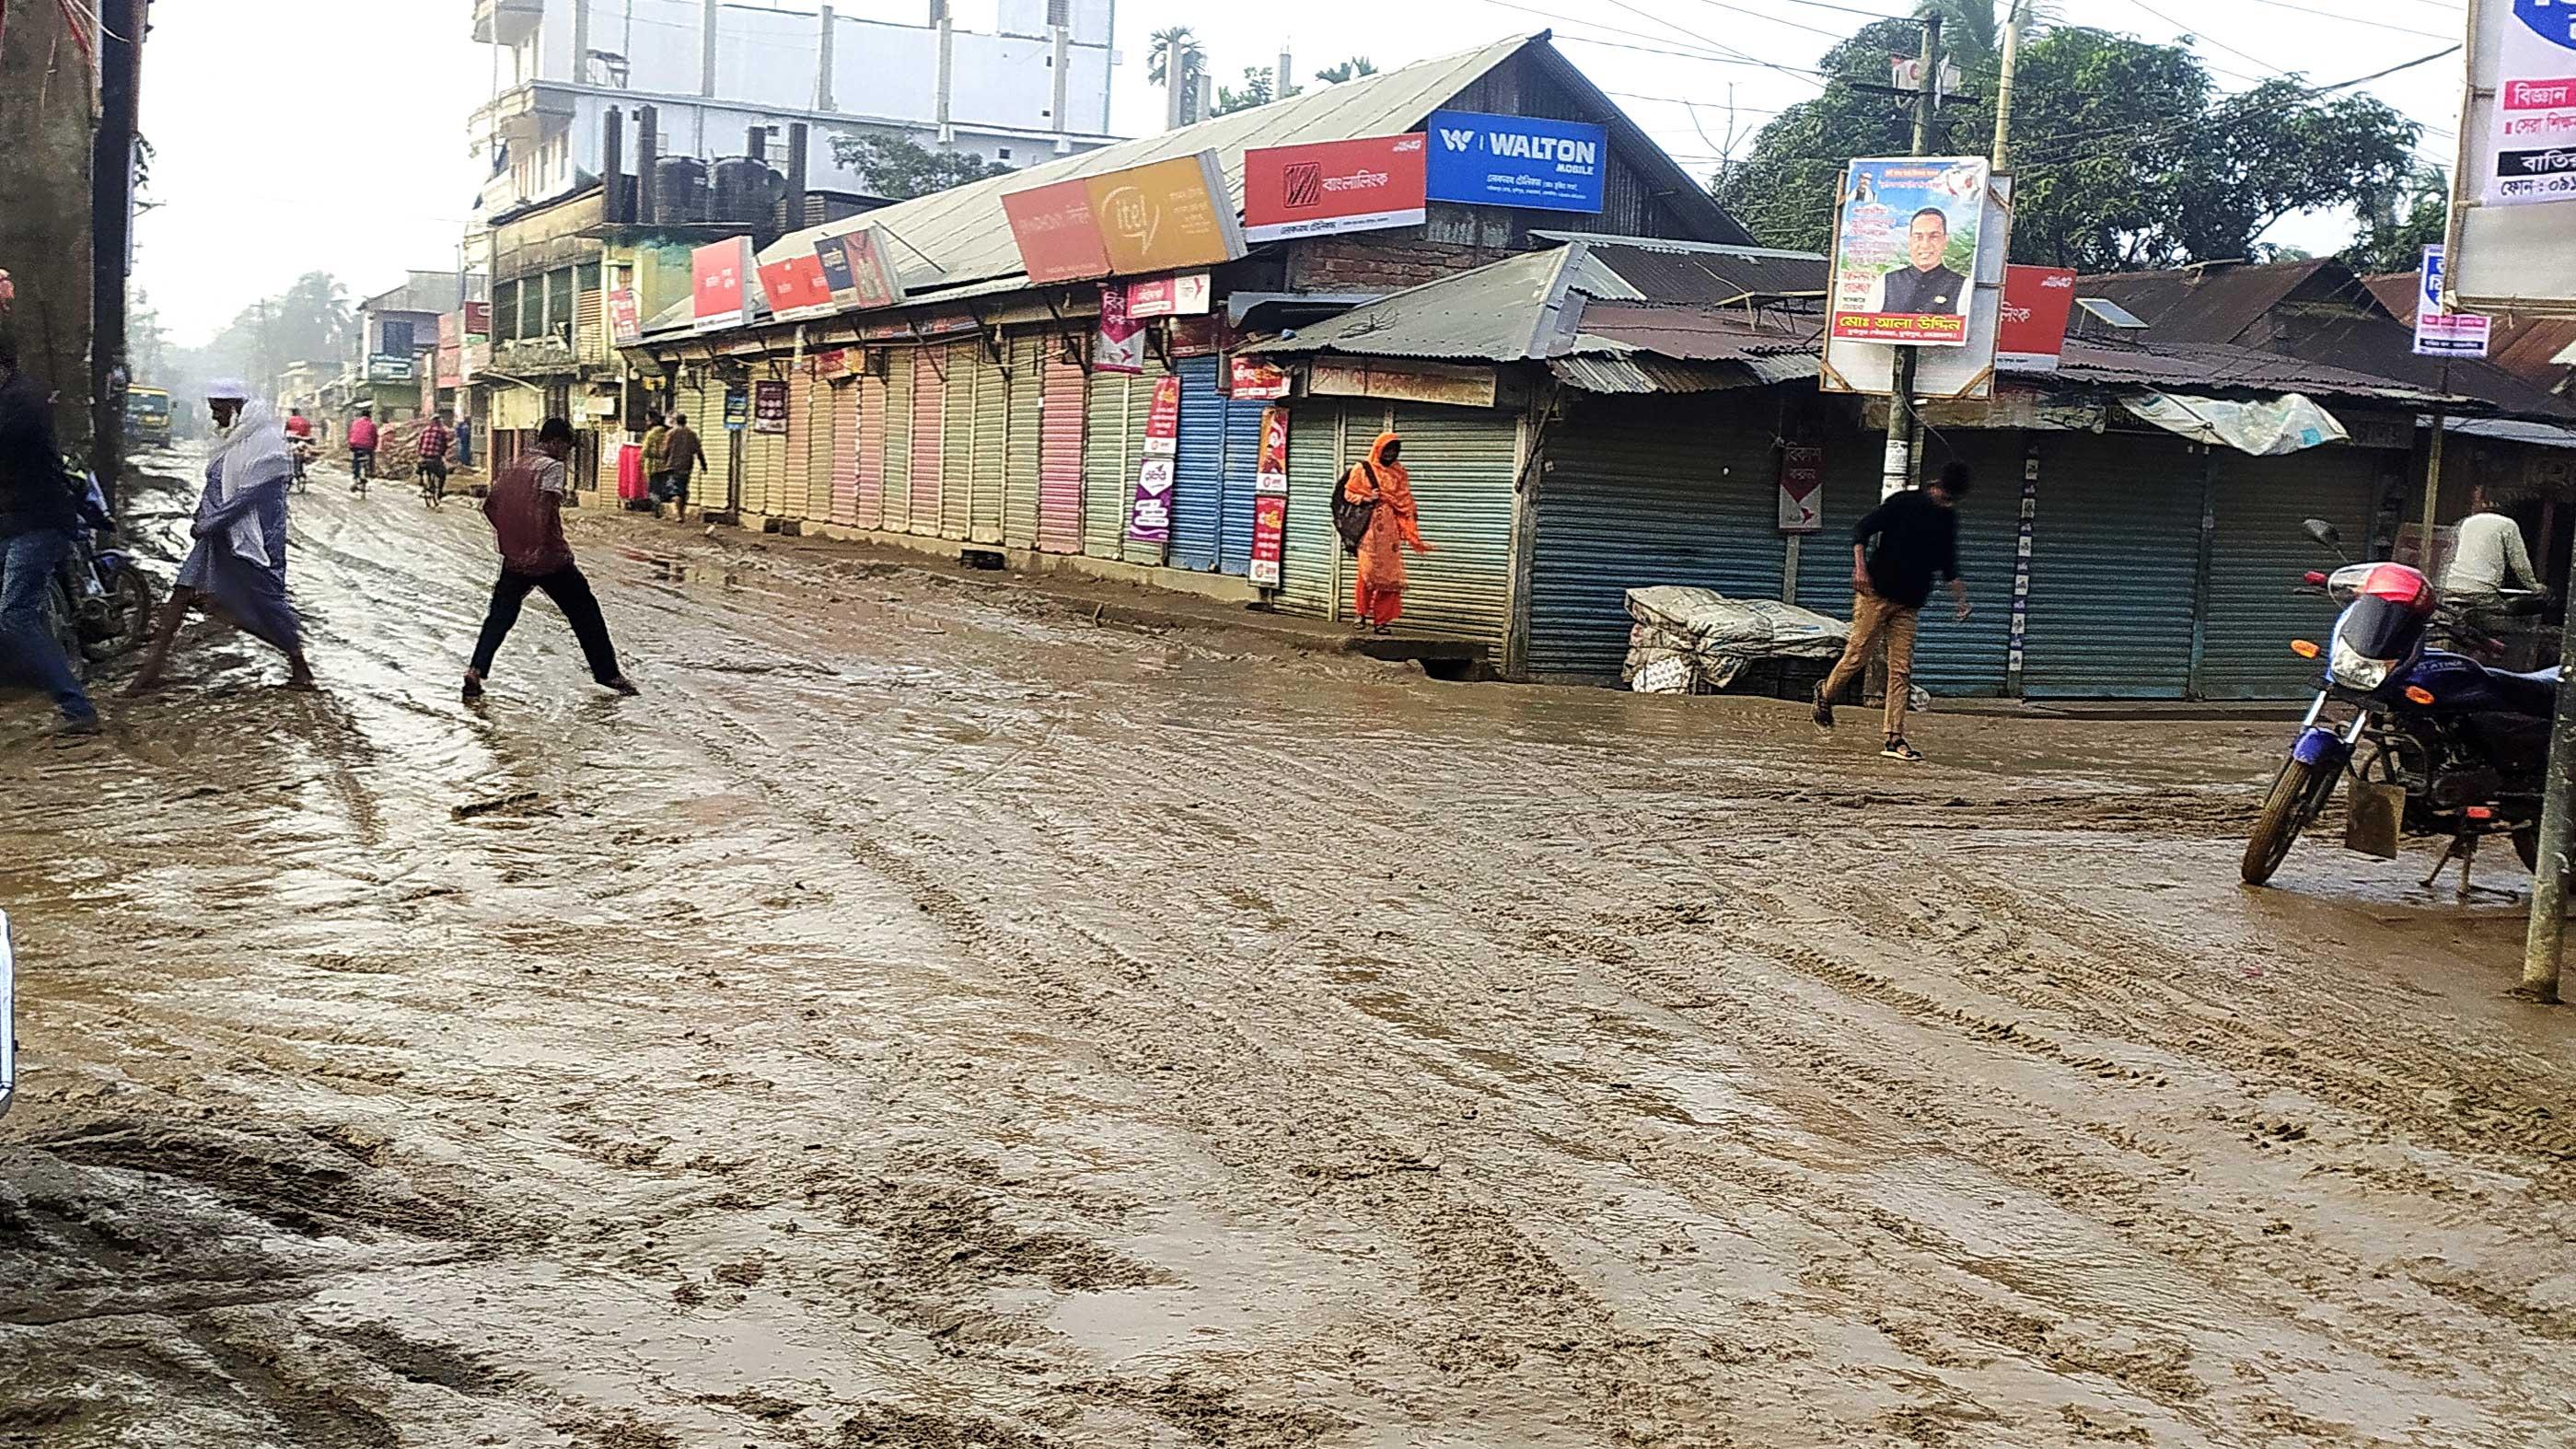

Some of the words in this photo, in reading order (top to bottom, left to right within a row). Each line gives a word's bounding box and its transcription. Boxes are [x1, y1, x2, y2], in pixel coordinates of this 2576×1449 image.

[2514, 82, 2569, 106] বিজ্ঞান
[1489, 133, 1595, 164] WALTON
[1322, 169, 1388, 191] বাংলালিংক
[1556, 163, 1594, 176] MOBILE
[2501, 179, 2535, 196] ফোন
[1116, 193, 1148, 231] itel
[1839, 315, 1871, 328] মোঃ
[1874, 317, 1912, 330] আলা
[1918, 315, 1962, 330] উদ্দিন
